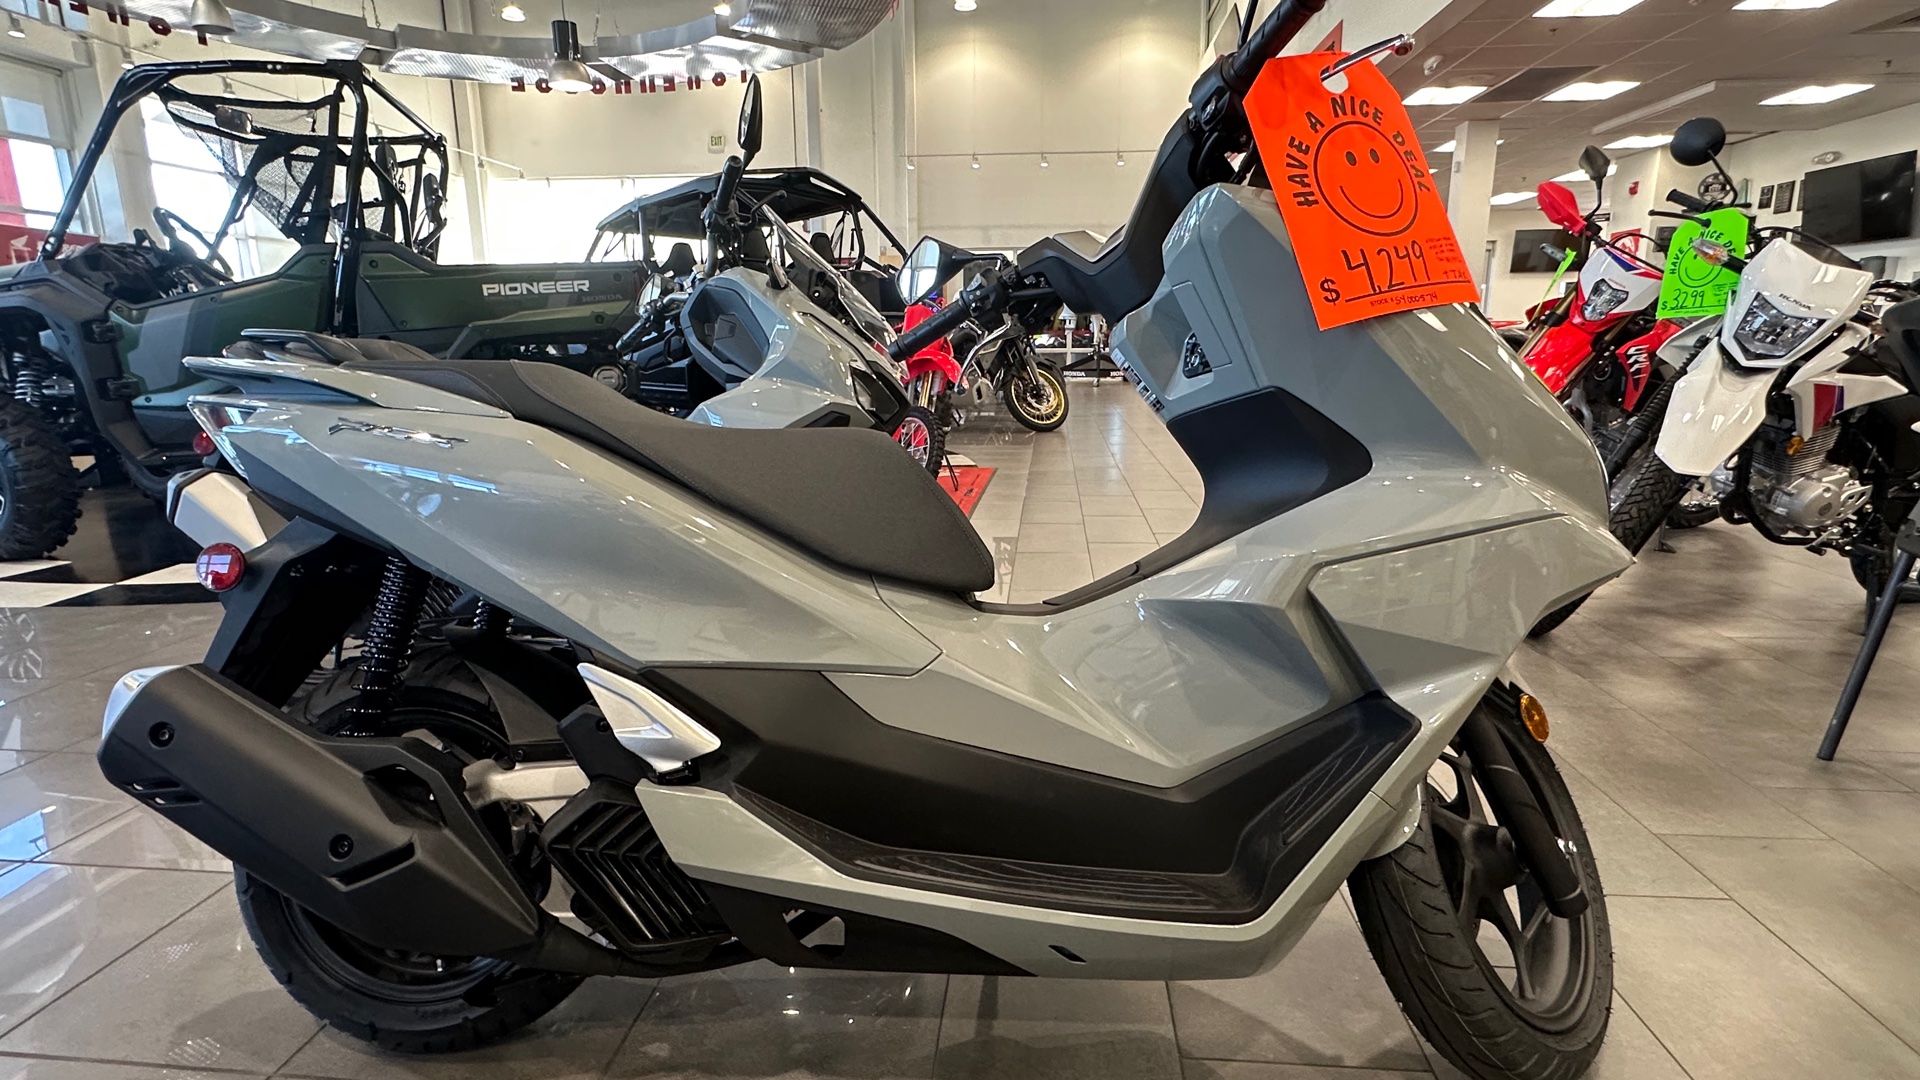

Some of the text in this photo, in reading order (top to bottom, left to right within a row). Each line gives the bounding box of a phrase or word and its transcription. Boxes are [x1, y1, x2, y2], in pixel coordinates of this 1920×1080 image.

[711, 136, 722, 146] EXIT
[1286, 95, 1431, 207] HAVE A NICE DEAL
[1669, 246, 1685, 275] HAVE
[1699, 230, 1724, 241] NICE
[481, 279, 590, 296] PIONEER
[1320, 277, 1341, 306] $
[1341, 240, 1430, 294] 4,249
[582, 293, 623, 303] HONDA
[1626, 344, 1650, 373] CRF
